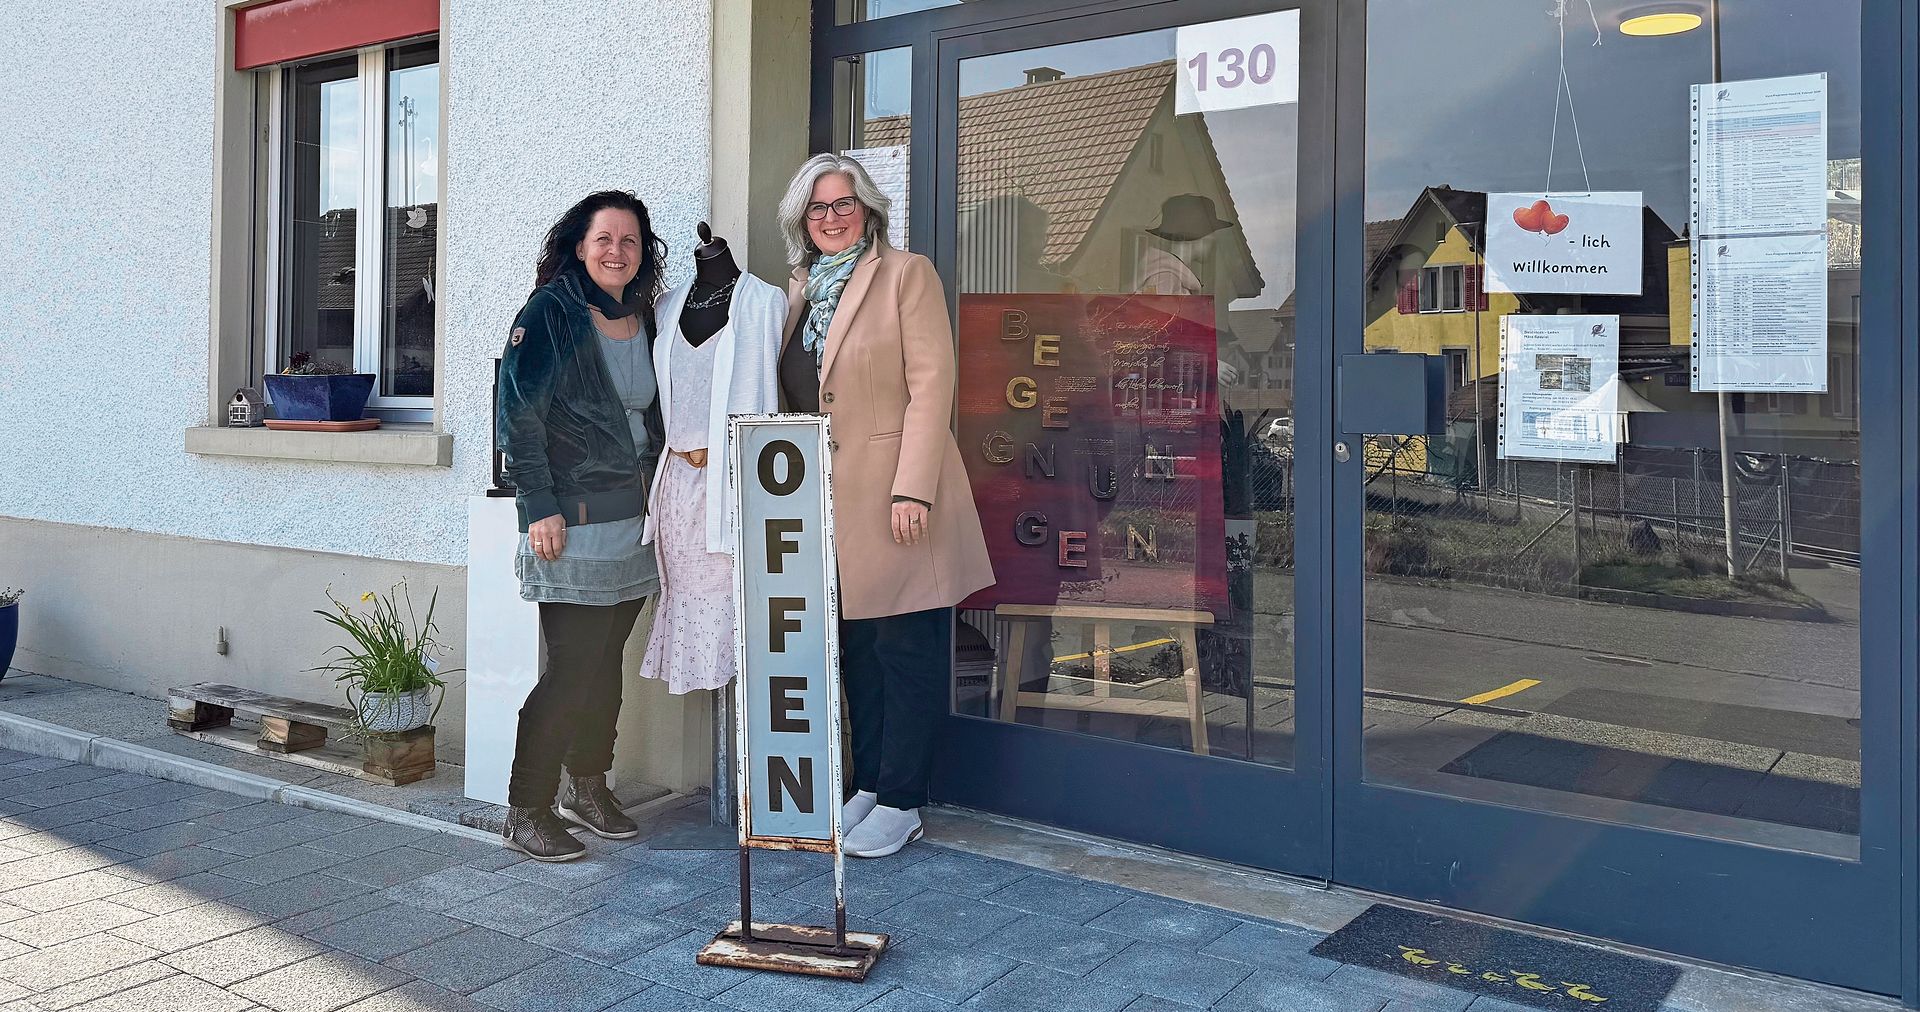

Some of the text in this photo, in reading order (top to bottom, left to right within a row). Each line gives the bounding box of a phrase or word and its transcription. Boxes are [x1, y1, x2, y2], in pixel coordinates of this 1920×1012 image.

[1188, 43, 1276, 91] 130
[1582, 234, 1611, 248] lich
[1513, 260, 1608, 274] Willkommen
[757, 439, 814, 814] OFFEN
